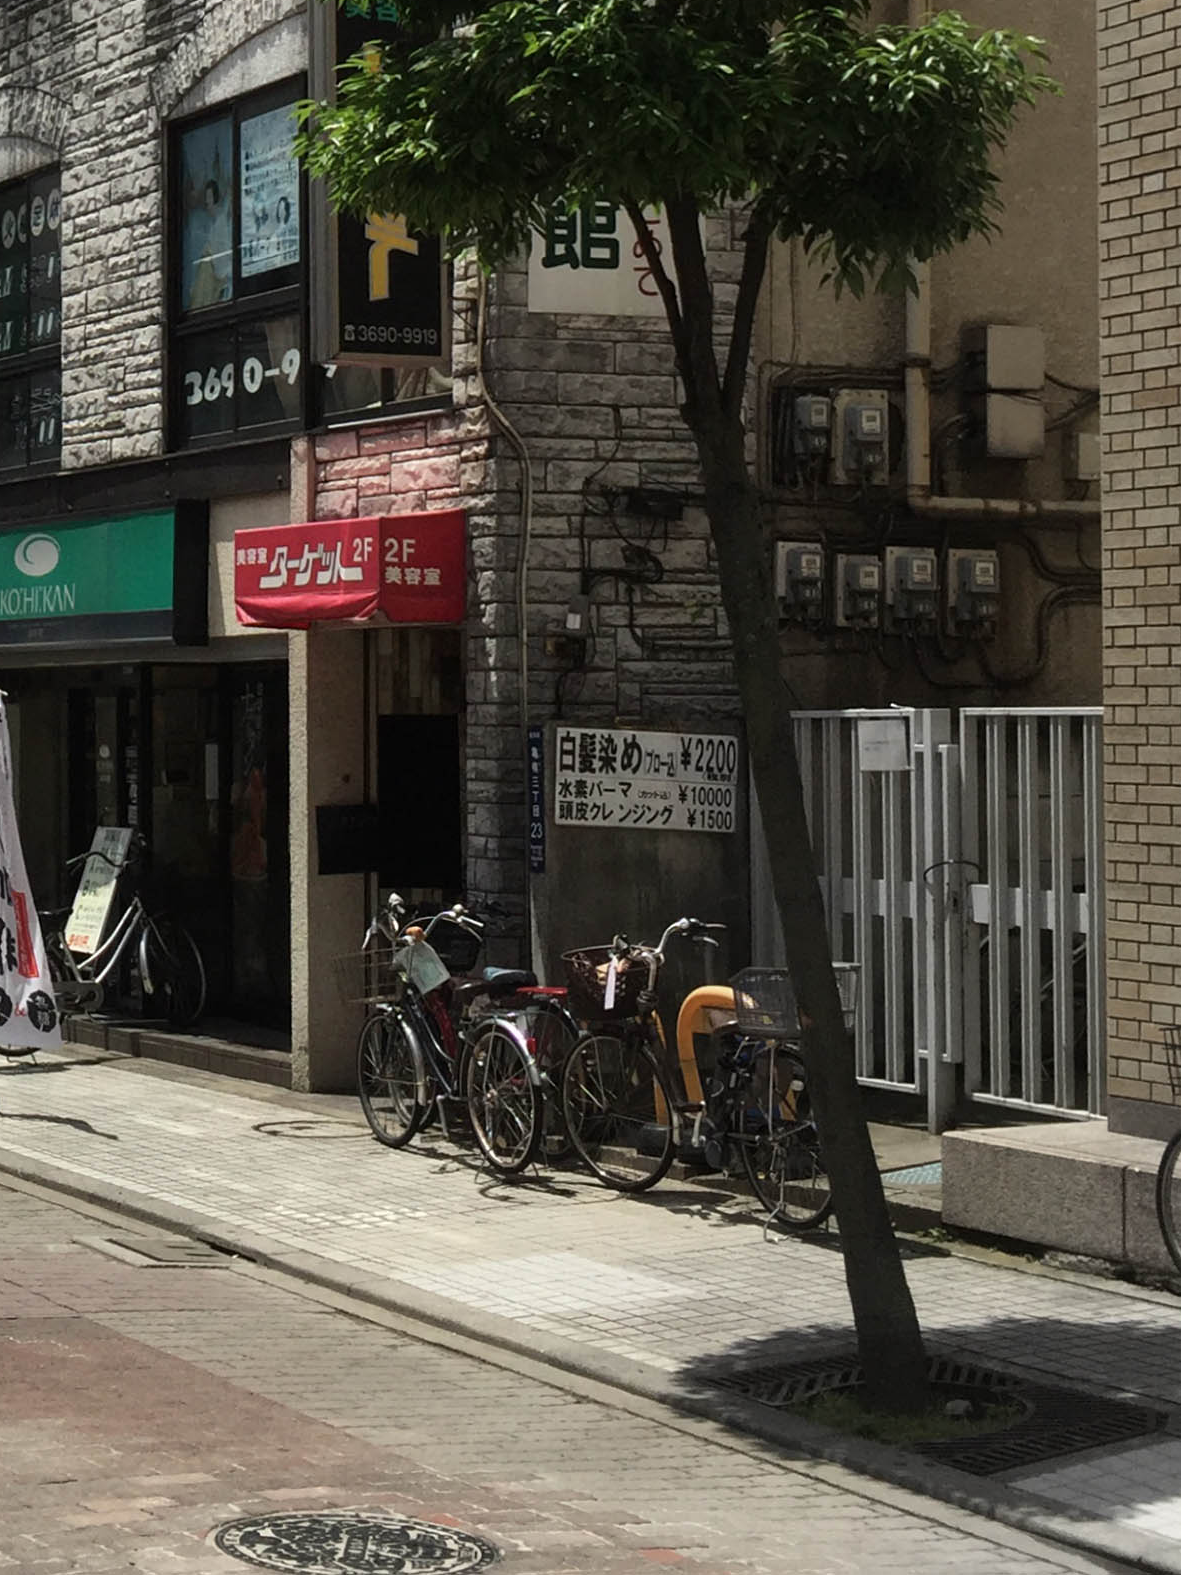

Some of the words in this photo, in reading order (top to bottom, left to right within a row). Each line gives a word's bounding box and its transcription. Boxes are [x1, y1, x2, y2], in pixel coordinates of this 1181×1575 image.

[358, 325, 437, 346] 3690-9919
[184, 348, 338, 408] 3690-9
[259, 541, 363, 589] ターゲット
[353, 537, 373, 562] 2F
[384, 538, 416, 563] 2F
[384, 566, 442, 586] 美容室
[559, 731, 642, 775] 白髪染め
[681, 737, 736, 774] ¥2200
[679, 785, 732, 808] ¥10000
[559, 800, 674, 825] 頭皮クレンジング
[687, 808, 732, 830] ¥1500
[530, 824, 543, 840] 23
